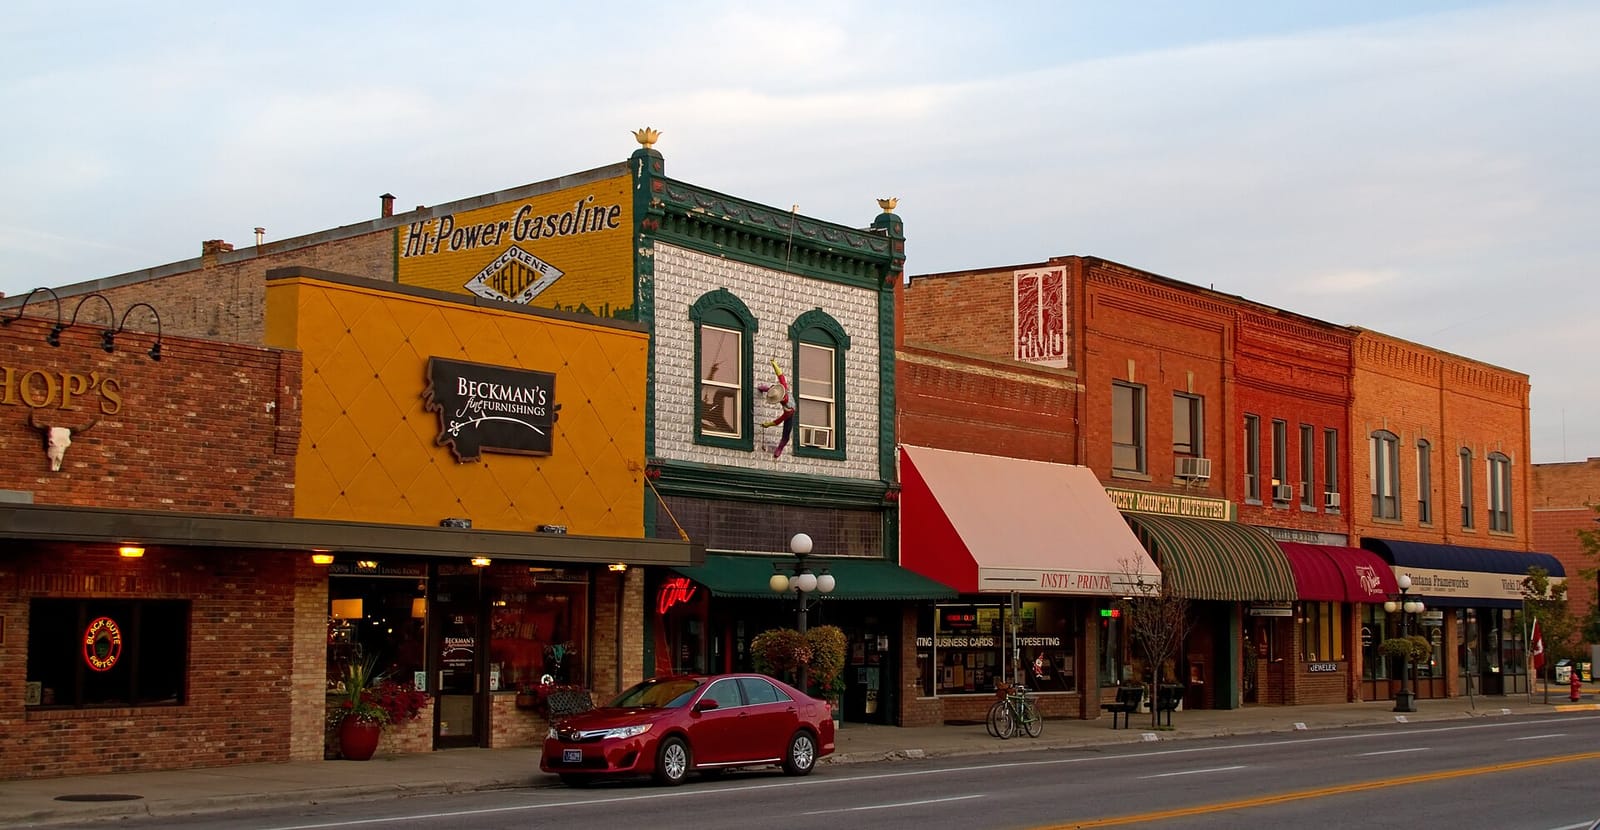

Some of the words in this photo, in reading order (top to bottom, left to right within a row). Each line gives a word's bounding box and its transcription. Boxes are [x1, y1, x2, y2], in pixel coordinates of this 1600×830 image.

[512, 195, 621, 242] Gasoline
[477, 248, 549, 283] HECCOLENE
[457, 376, 547, 405] BECKMAN'S
[455, 396, 484, 418] fine
[483, 400, 545, 417] FURNISHINGS
[1136, 493, 1178, 514] MOUNTAIN
[1180, 498, 1224, 518] OUTFITTER
[1041, 573, 1070, 588] INSTY
[1077, 575, 1112, 590] PRINTS
[1433, 575, 1469, 588] Frameworks
[86, 619, 105, 645] BLACK
[105, 620, 121, 645] BUTTE
[1015, 637, 1060, 646] TYPESETTING
[934, 637, 968, 647] BUSINESS
[969, 637, 994, 647] CARDS
[89, 655, 115, 668] PORTER
[1309, 663, 1337, 672] JEWELER
